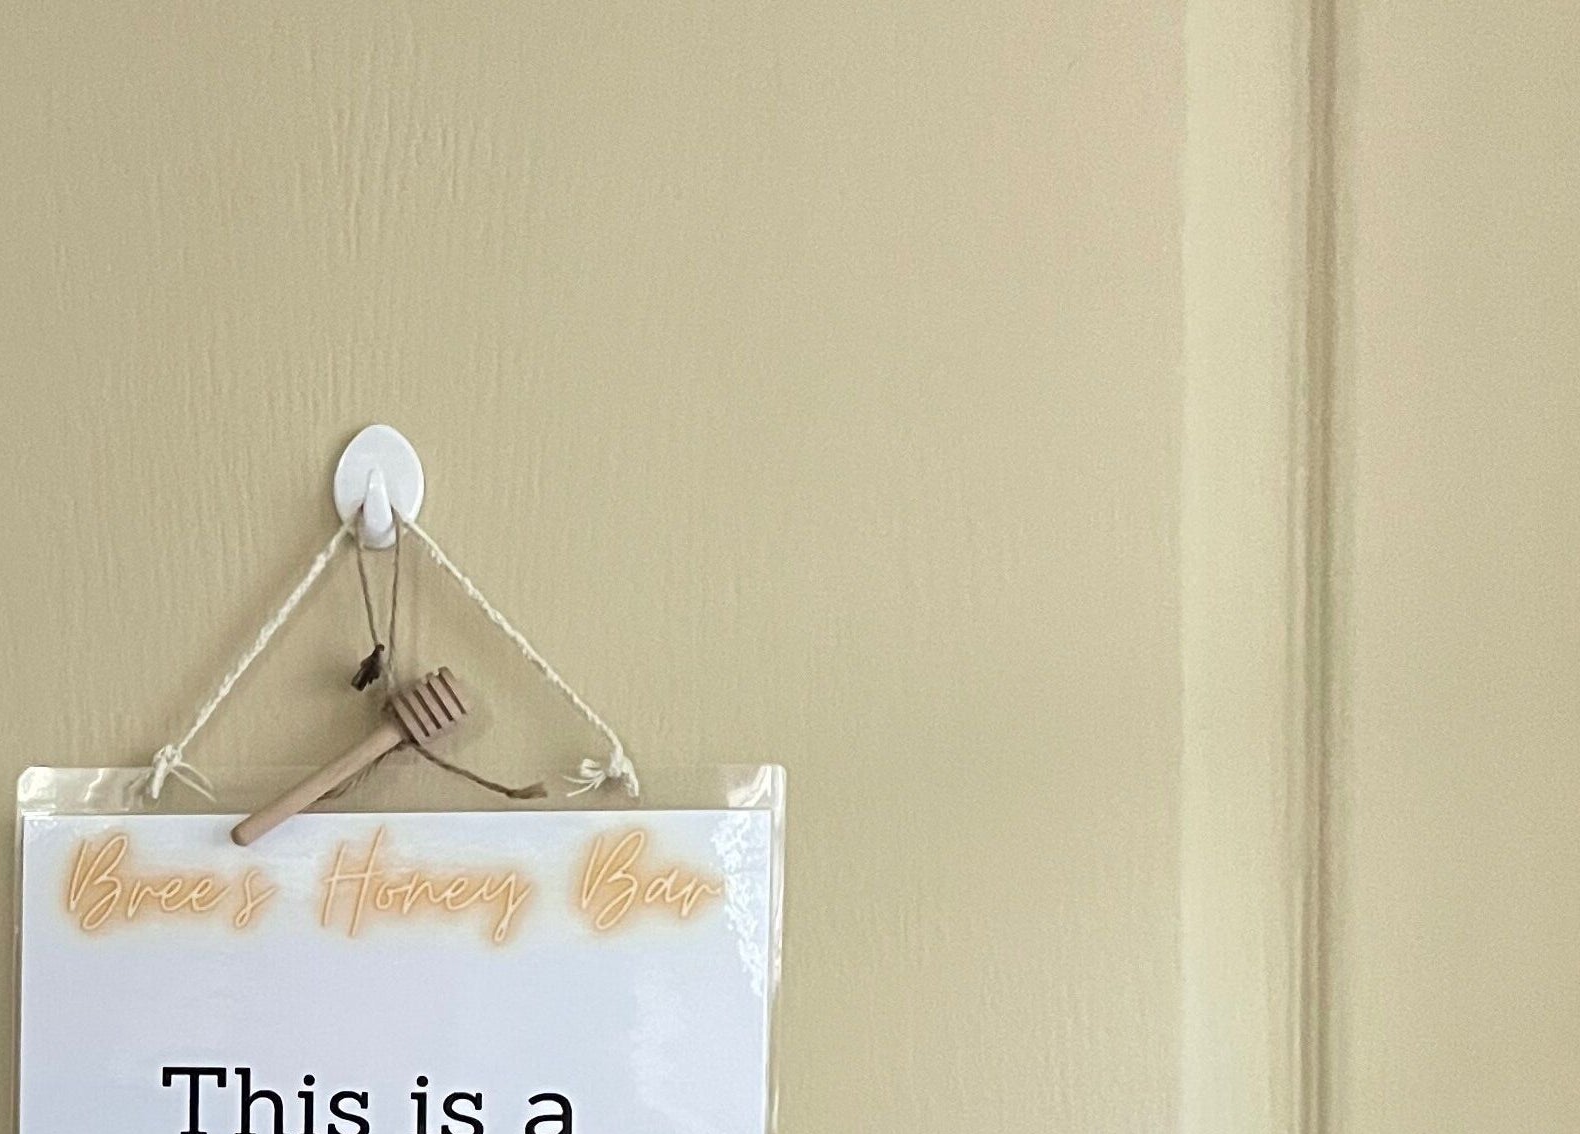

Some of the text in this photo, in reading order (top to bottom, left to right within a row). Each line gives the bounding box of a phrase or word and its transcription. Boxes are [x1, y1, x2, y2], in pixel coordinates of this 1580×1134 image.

[69, 824, 722, 943] Brees Honey Bar
